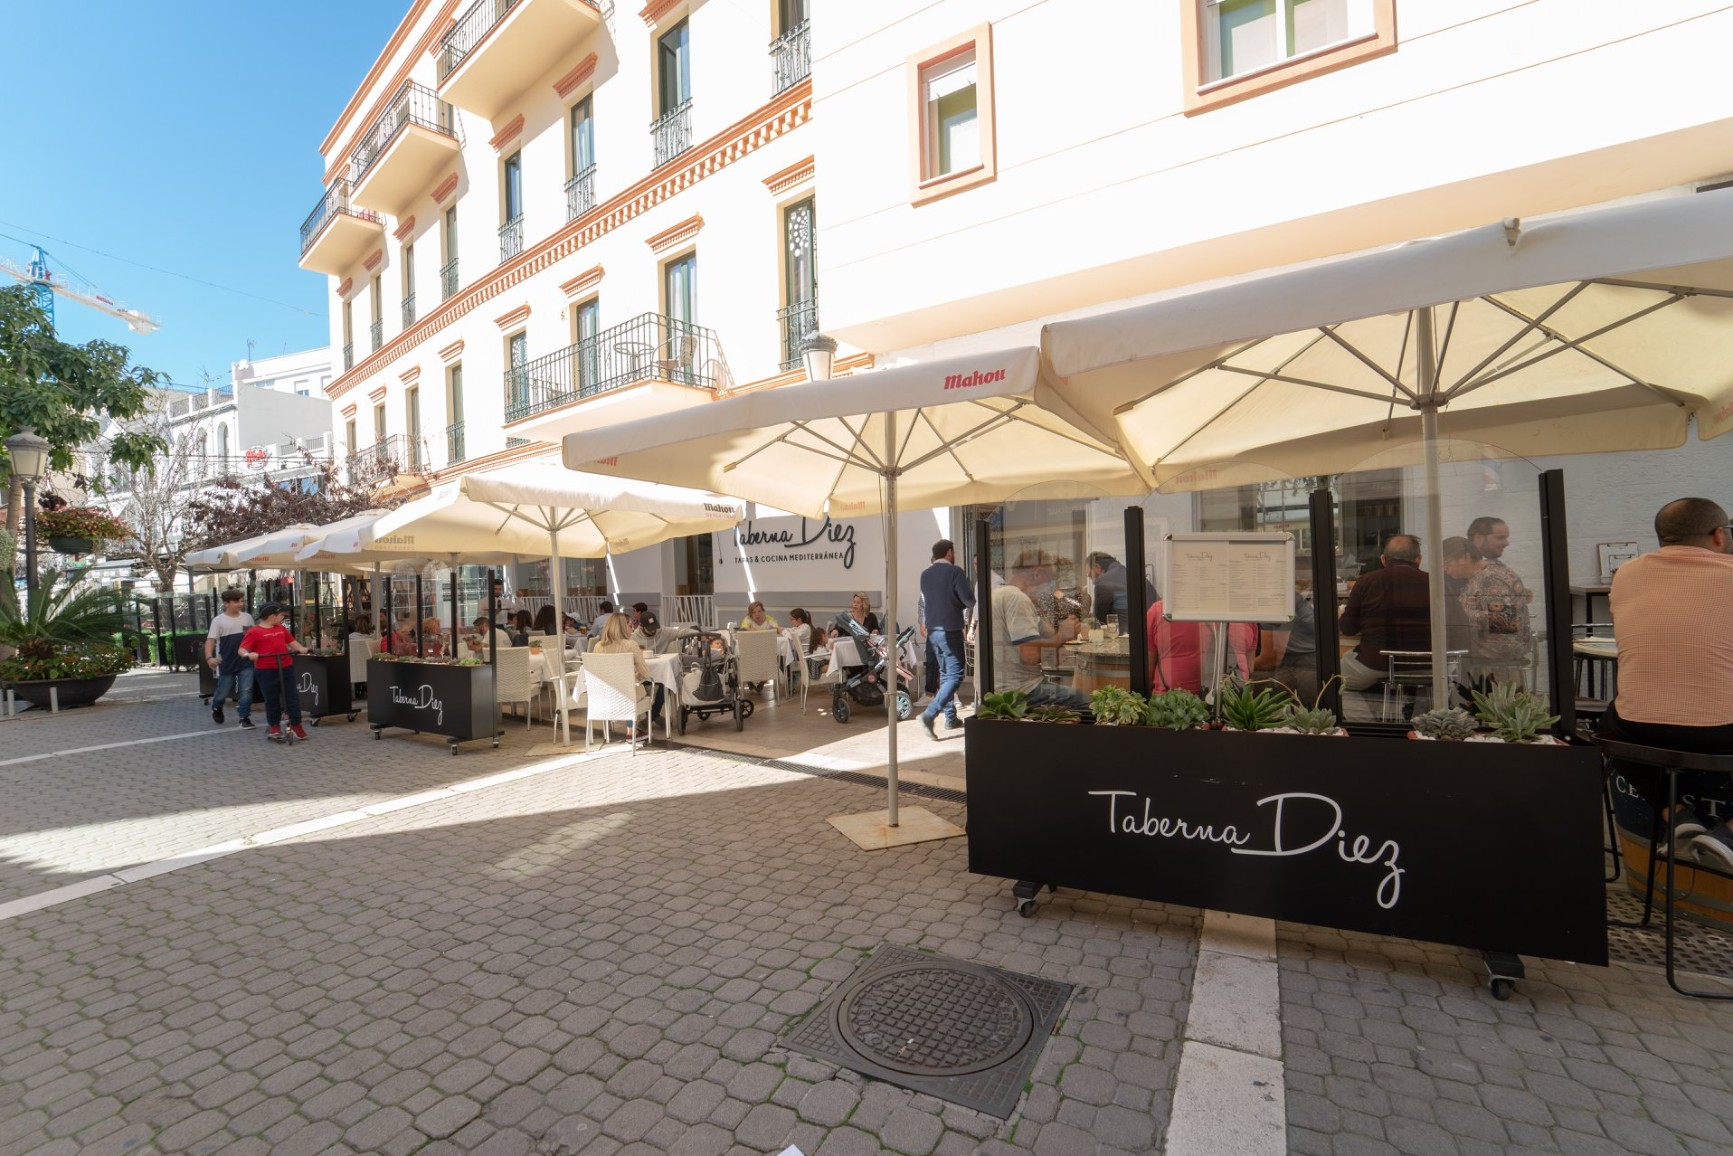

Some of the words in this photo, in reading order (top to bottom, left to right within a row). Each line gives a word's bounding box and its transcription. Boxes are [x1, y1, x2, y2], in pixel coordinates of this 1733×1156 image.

[944, 369, 1006, 390] Mahou
[703, 503, 735, 513] Mahou
[761, 554, 788, 563] COCINA
[789, 551, 844, 562] MEDITERRÁNEA
[389, 686, 419, 705] Taberna
[414, 684, 443, 726] Diez
[1088, 791, 1250, 845] Taberna
[1231, 792, 1405, 909] Diez
